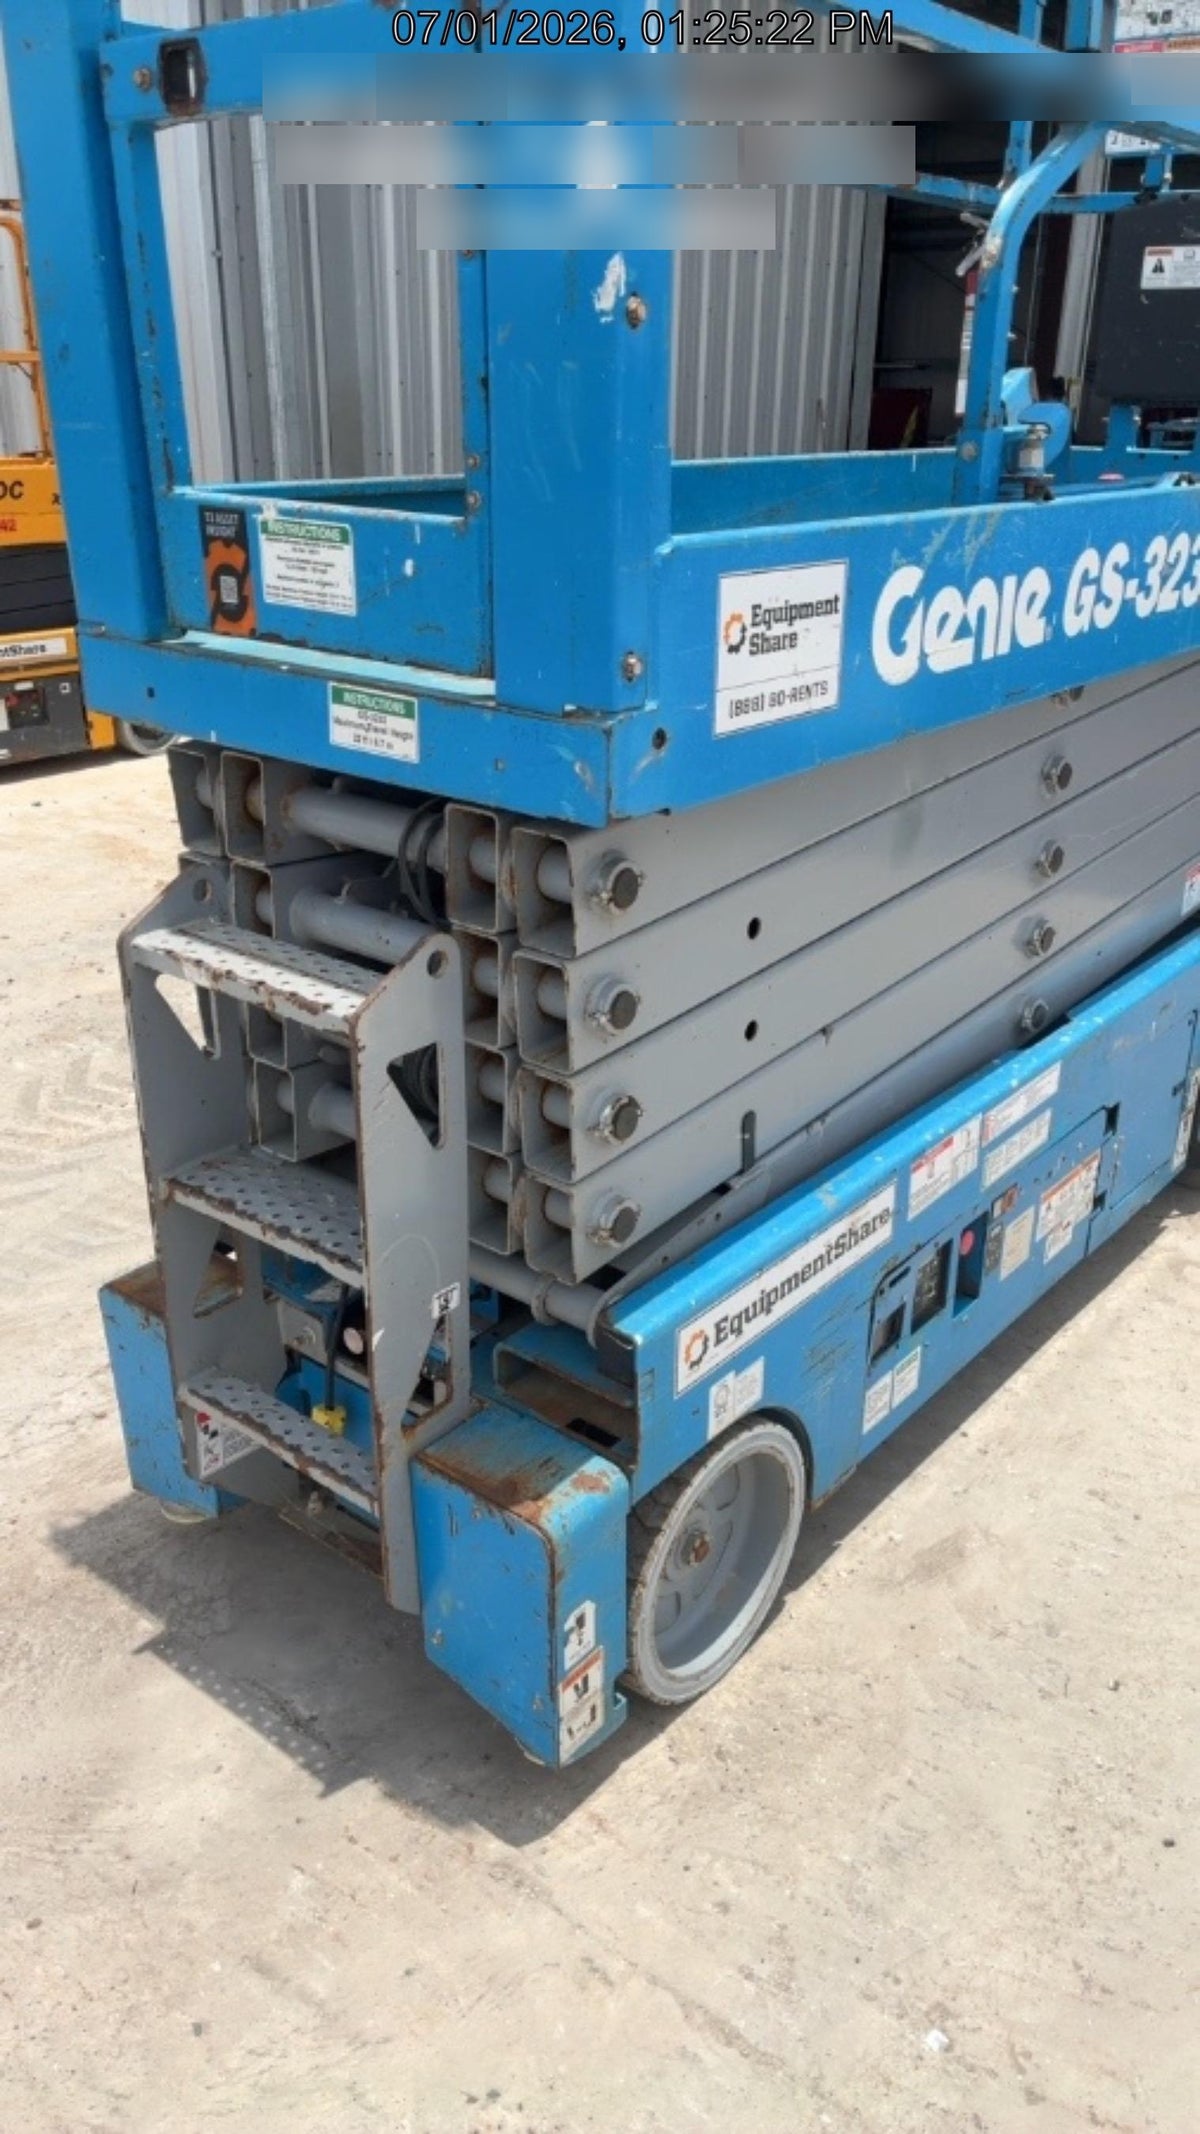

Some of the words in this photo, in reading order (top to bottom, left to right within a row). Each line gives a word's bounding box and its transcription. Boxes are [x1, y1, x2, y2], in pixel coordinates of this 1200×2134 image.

[267, 520, 342, 542] INSTRUCTIONS
[751, 594, 840, 631] Equipment
[872, 565, 1051, 686] Genie
[749, 631, 798, 656] Share
[713, 1206, 891, 1348] EquipmentShare
